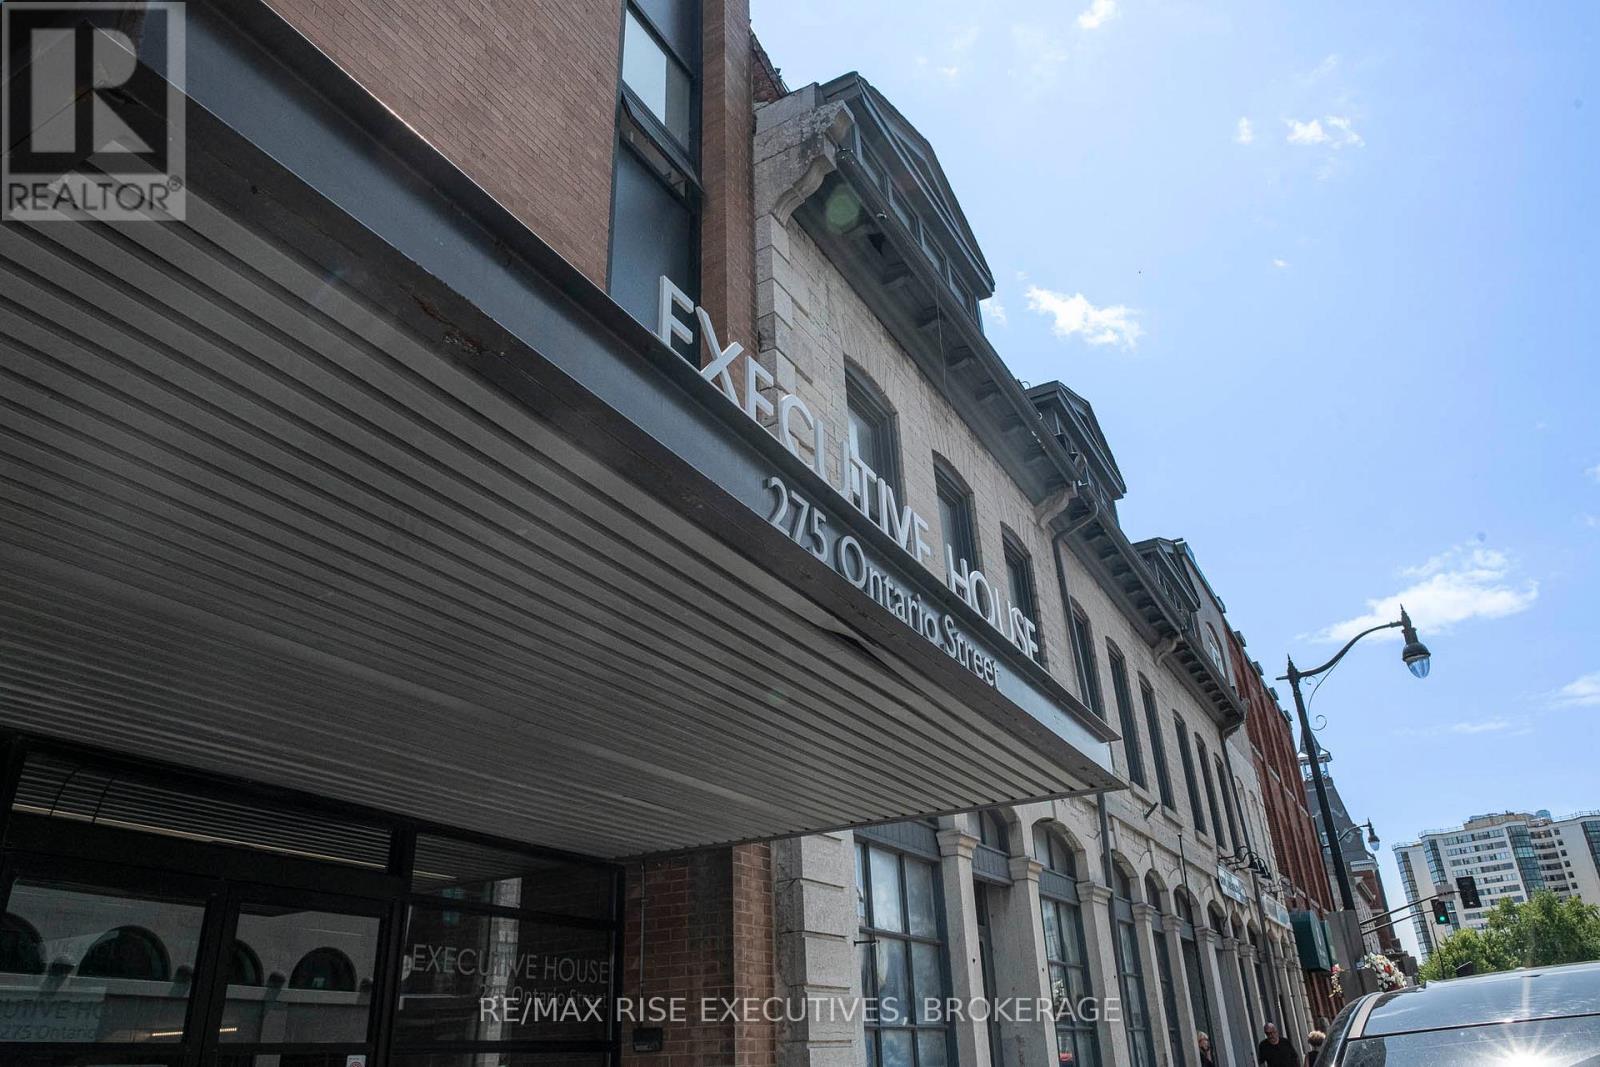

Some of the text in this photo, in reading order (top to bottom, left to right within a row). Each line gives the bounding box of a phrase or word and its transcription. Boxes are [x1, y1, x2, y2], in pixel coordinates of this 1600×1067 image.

[766, 477, 1000, 690] 275 Ontario Street
[945, 544, 1039, 663] HOUSE
[411, 943, 609, 985] EXECUVE HOUSE
